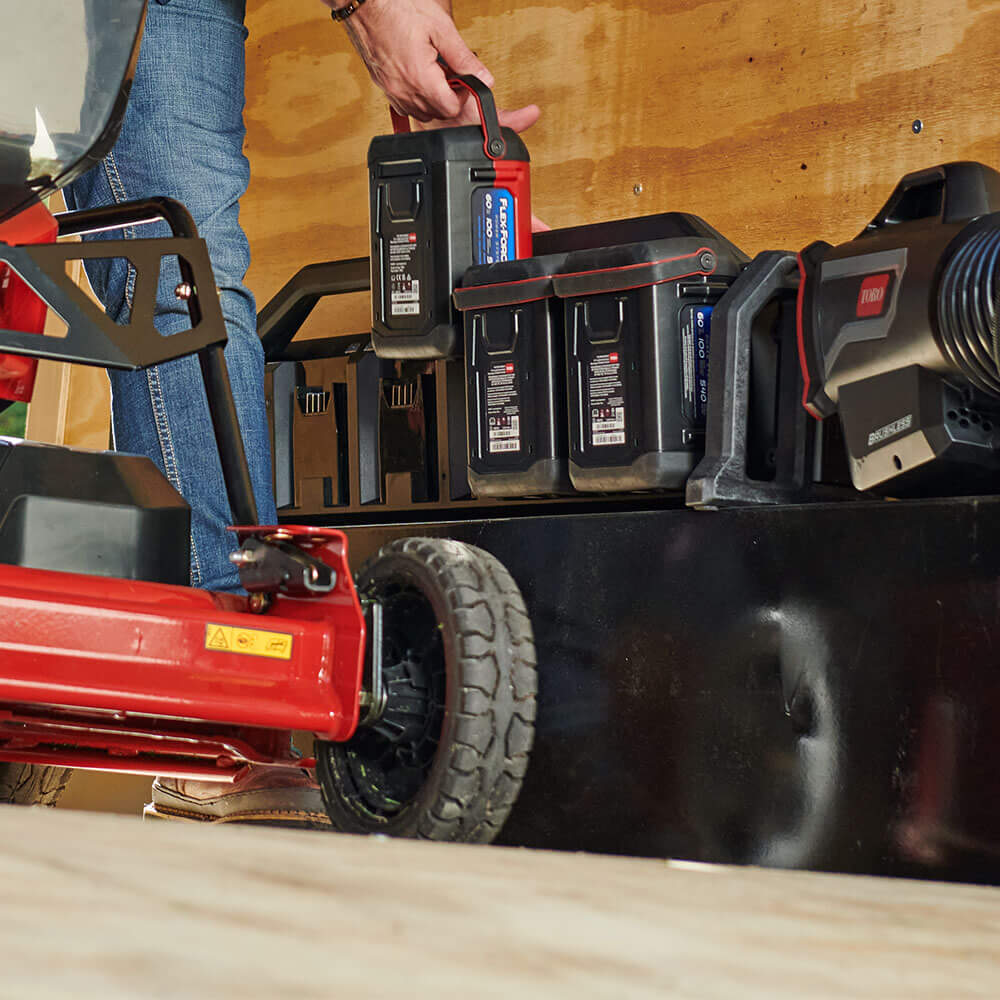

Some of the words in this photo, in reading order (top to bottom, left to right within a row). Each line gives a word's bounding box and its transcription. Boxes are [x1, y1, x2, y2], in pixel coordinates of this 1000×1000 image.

[499, 197, 509, 263] FLEX-FORC
[861, 286, 885, 305] TORO
[696, 312, 705, 328] 60
[697, 338, 706, 359] 100
